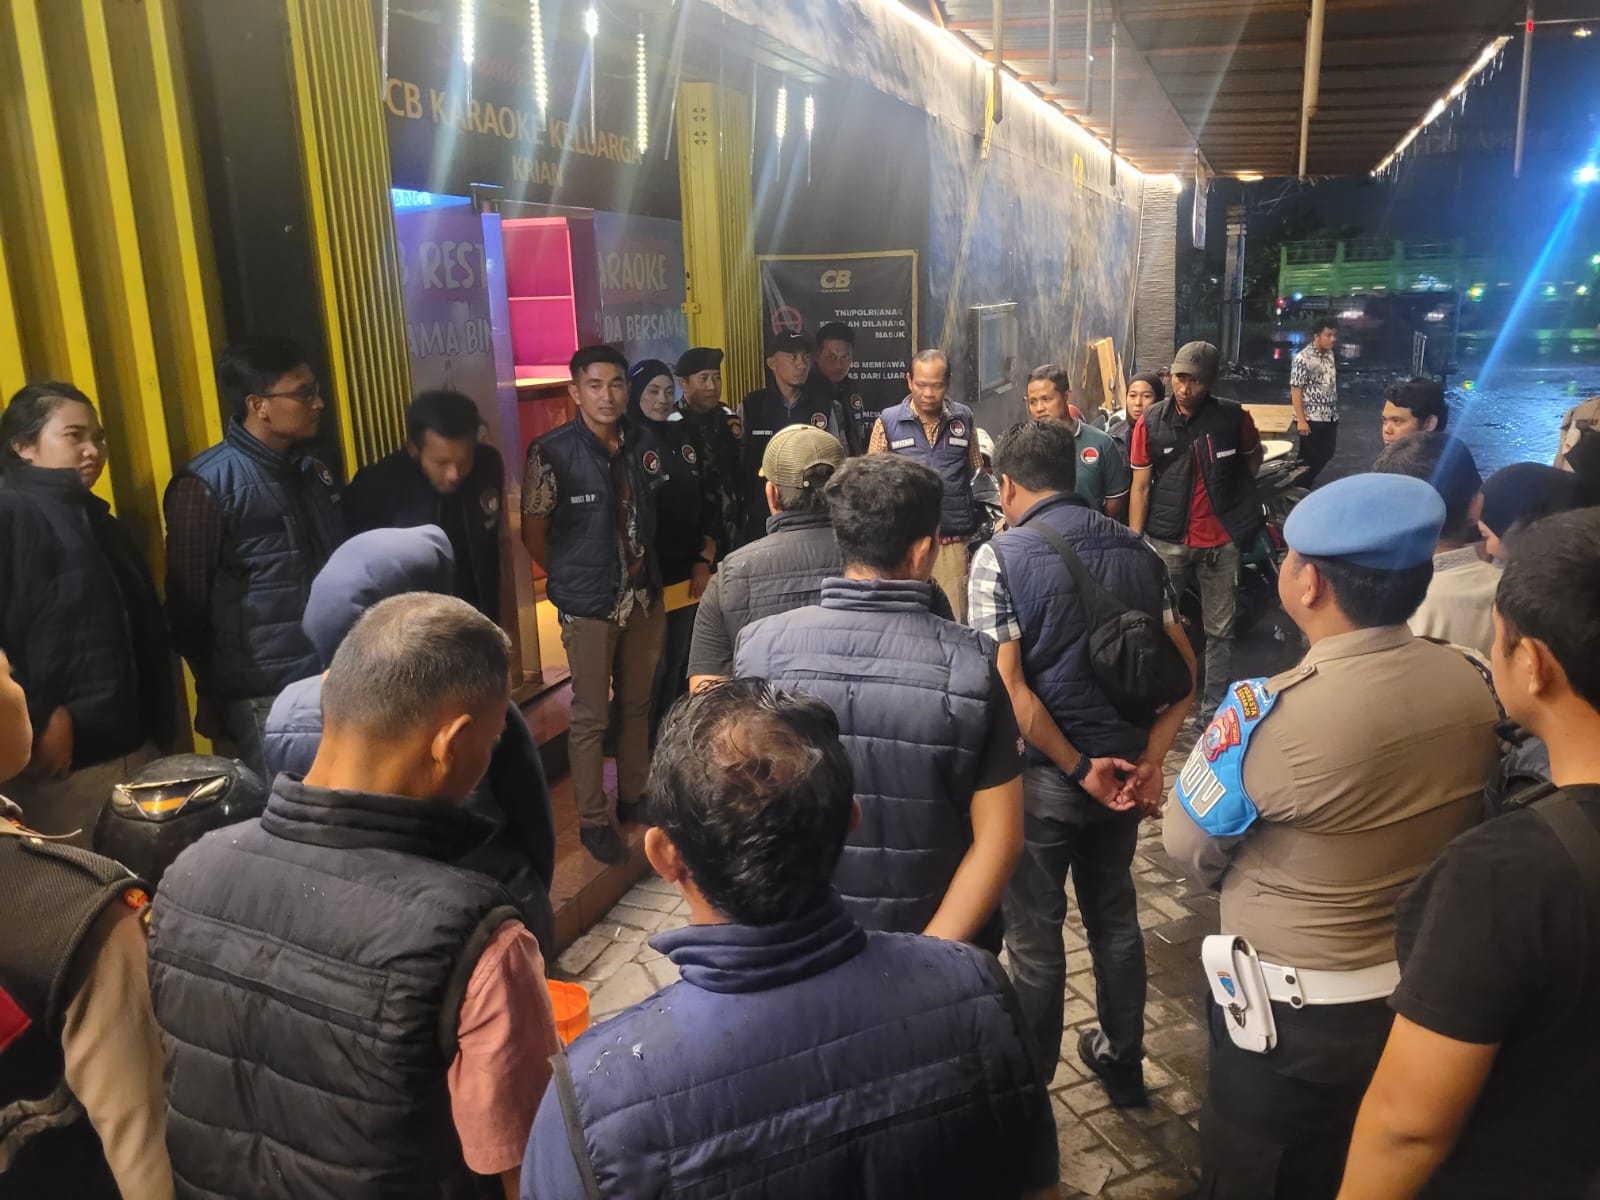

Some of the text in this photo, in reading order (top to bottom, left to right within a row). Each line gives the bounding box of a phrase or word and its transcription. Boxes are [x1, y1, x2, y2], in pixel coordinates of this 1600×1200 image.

[386, 78, 423, 120] CB
[431, 88, 545, 145] KARAOKE
[549, 118, 643, 165] KELUARGA
[511, 154, 563, 188] KRIAN
[820, 269, 852, 289] CB
[862, 319, 906, 328] DILARANG
[875, 331, 906, 339] MASUK
[861, 360, 906, 369] MEMBAWA
[861, 372, 881, 380] DARI
[883, 372, 905, 380] LUAR
